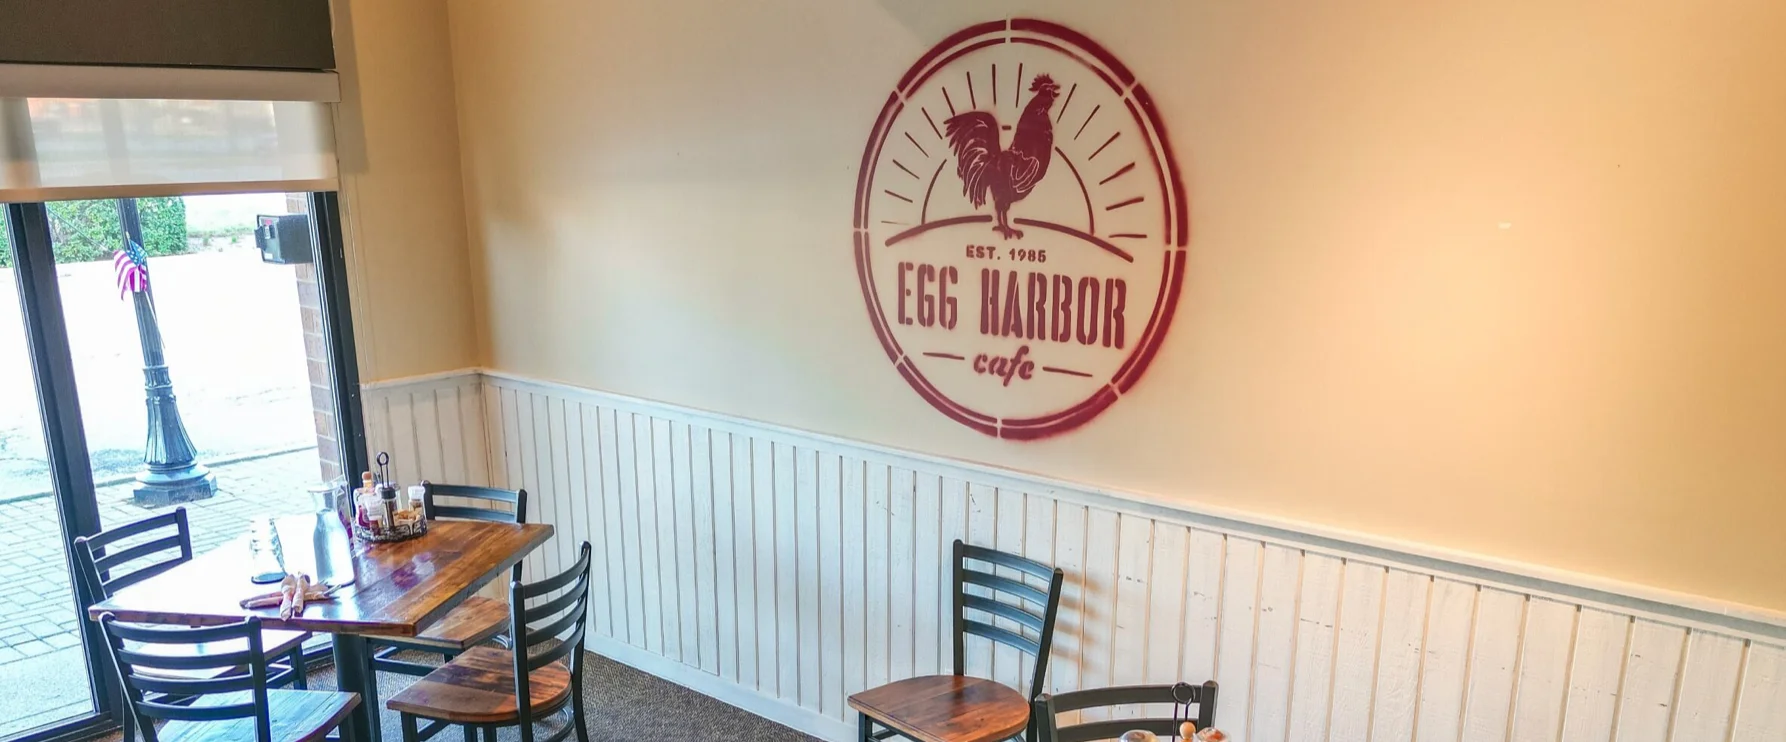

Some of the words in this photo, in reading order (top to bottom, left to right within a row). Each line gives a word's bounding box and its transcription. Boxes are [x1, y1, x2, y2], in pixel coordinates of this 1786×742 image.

[966, 244, 1001, 260] EST.
[1009, 248, 1047, 263] 1985
[897, 262, 959, 330] EGG
[980, 268, 1127, 350] HARBOR
[973, 345, 1035, 387] cafe
